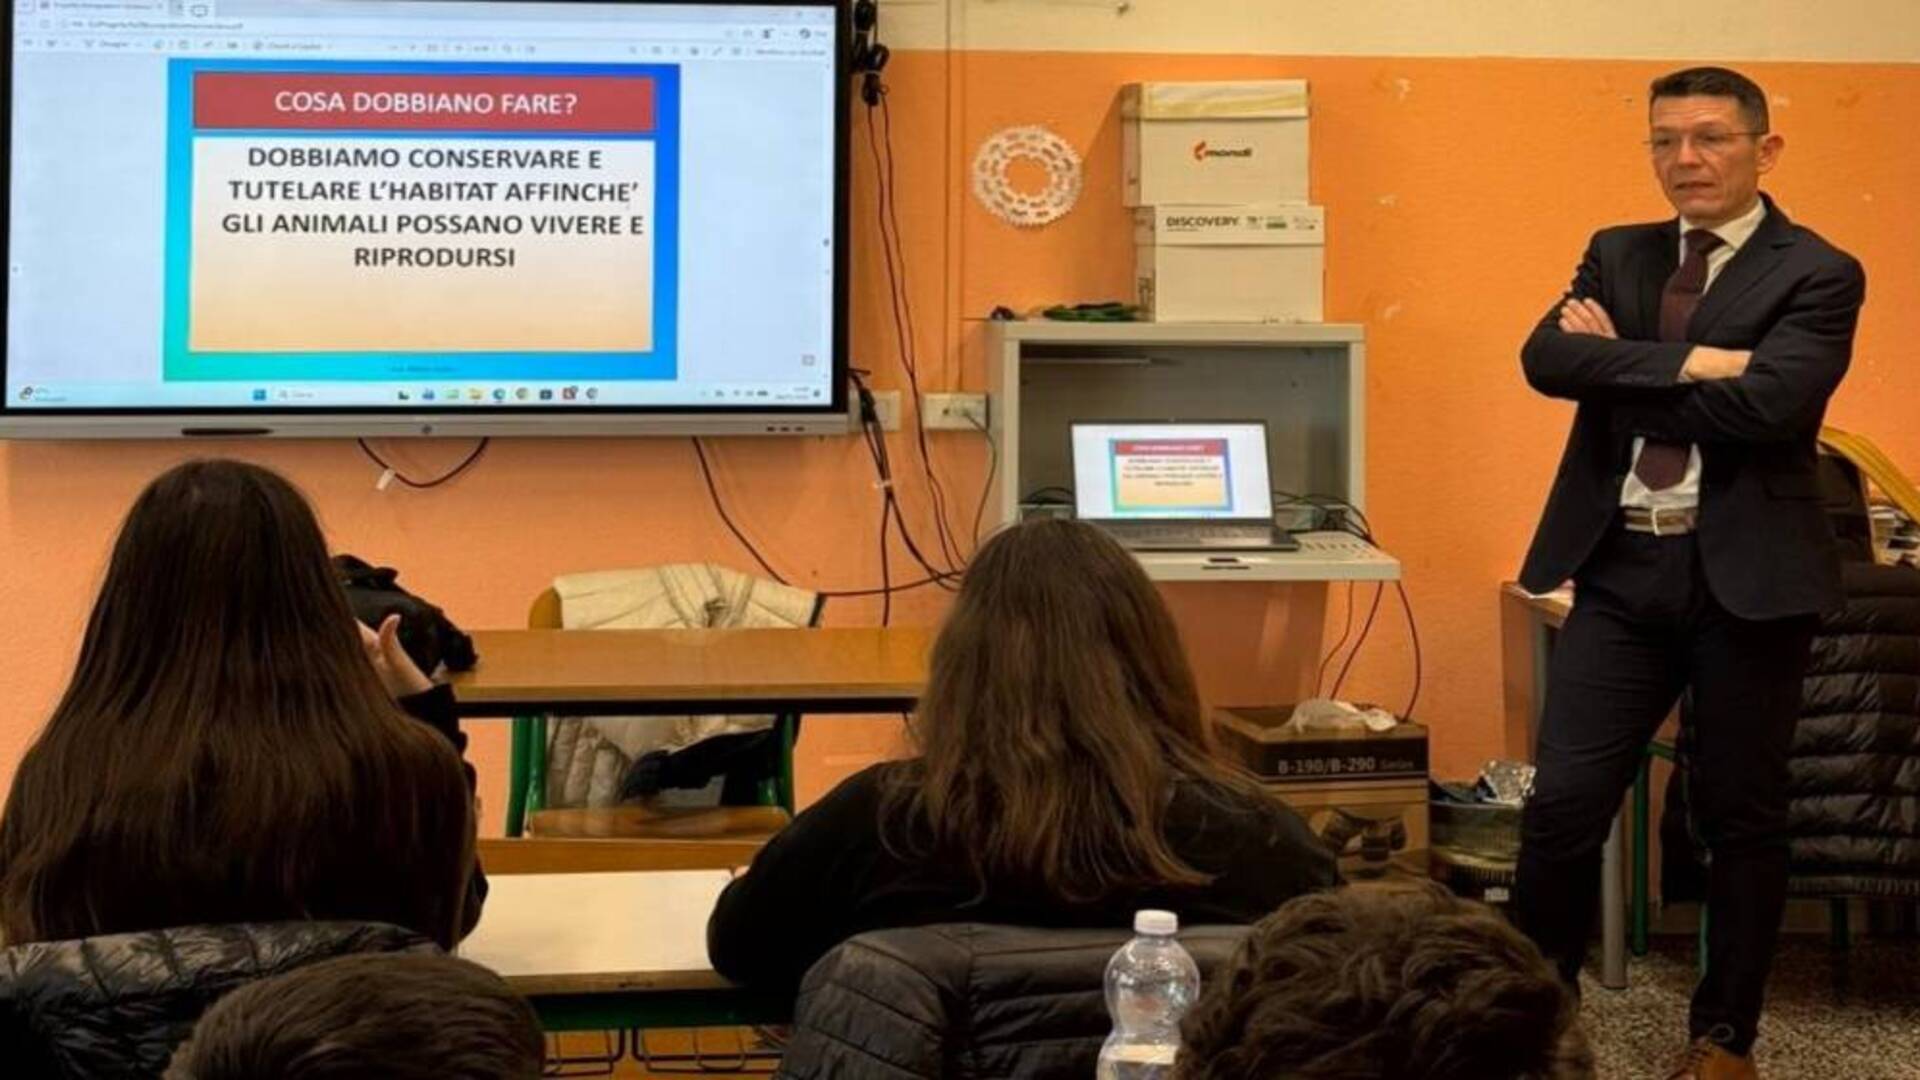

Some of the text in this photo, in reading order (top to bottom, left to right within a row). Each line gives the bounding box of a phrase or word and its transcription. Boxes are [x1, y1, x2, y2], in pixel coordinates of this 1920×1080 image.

[274, 91, 578, 115] COSA DOBBIANO FARE?
[248, 147, 603, 169] DOBBIAMO CONSERVARE E
[1203, 146, 1254, 159] mondi
[228, 180, 639, 202] TUTELARE L’HABITAT AFFINCHE’
[222, 213, 644, 235] GLI ANIMALI POSSANO VIVERE E
[1165, 215, 1240, 227] DISCOVERY
[354, 247, 516, 268] RIPRODURSI
[1277, 756, 1376, 775] B-190/B-290
